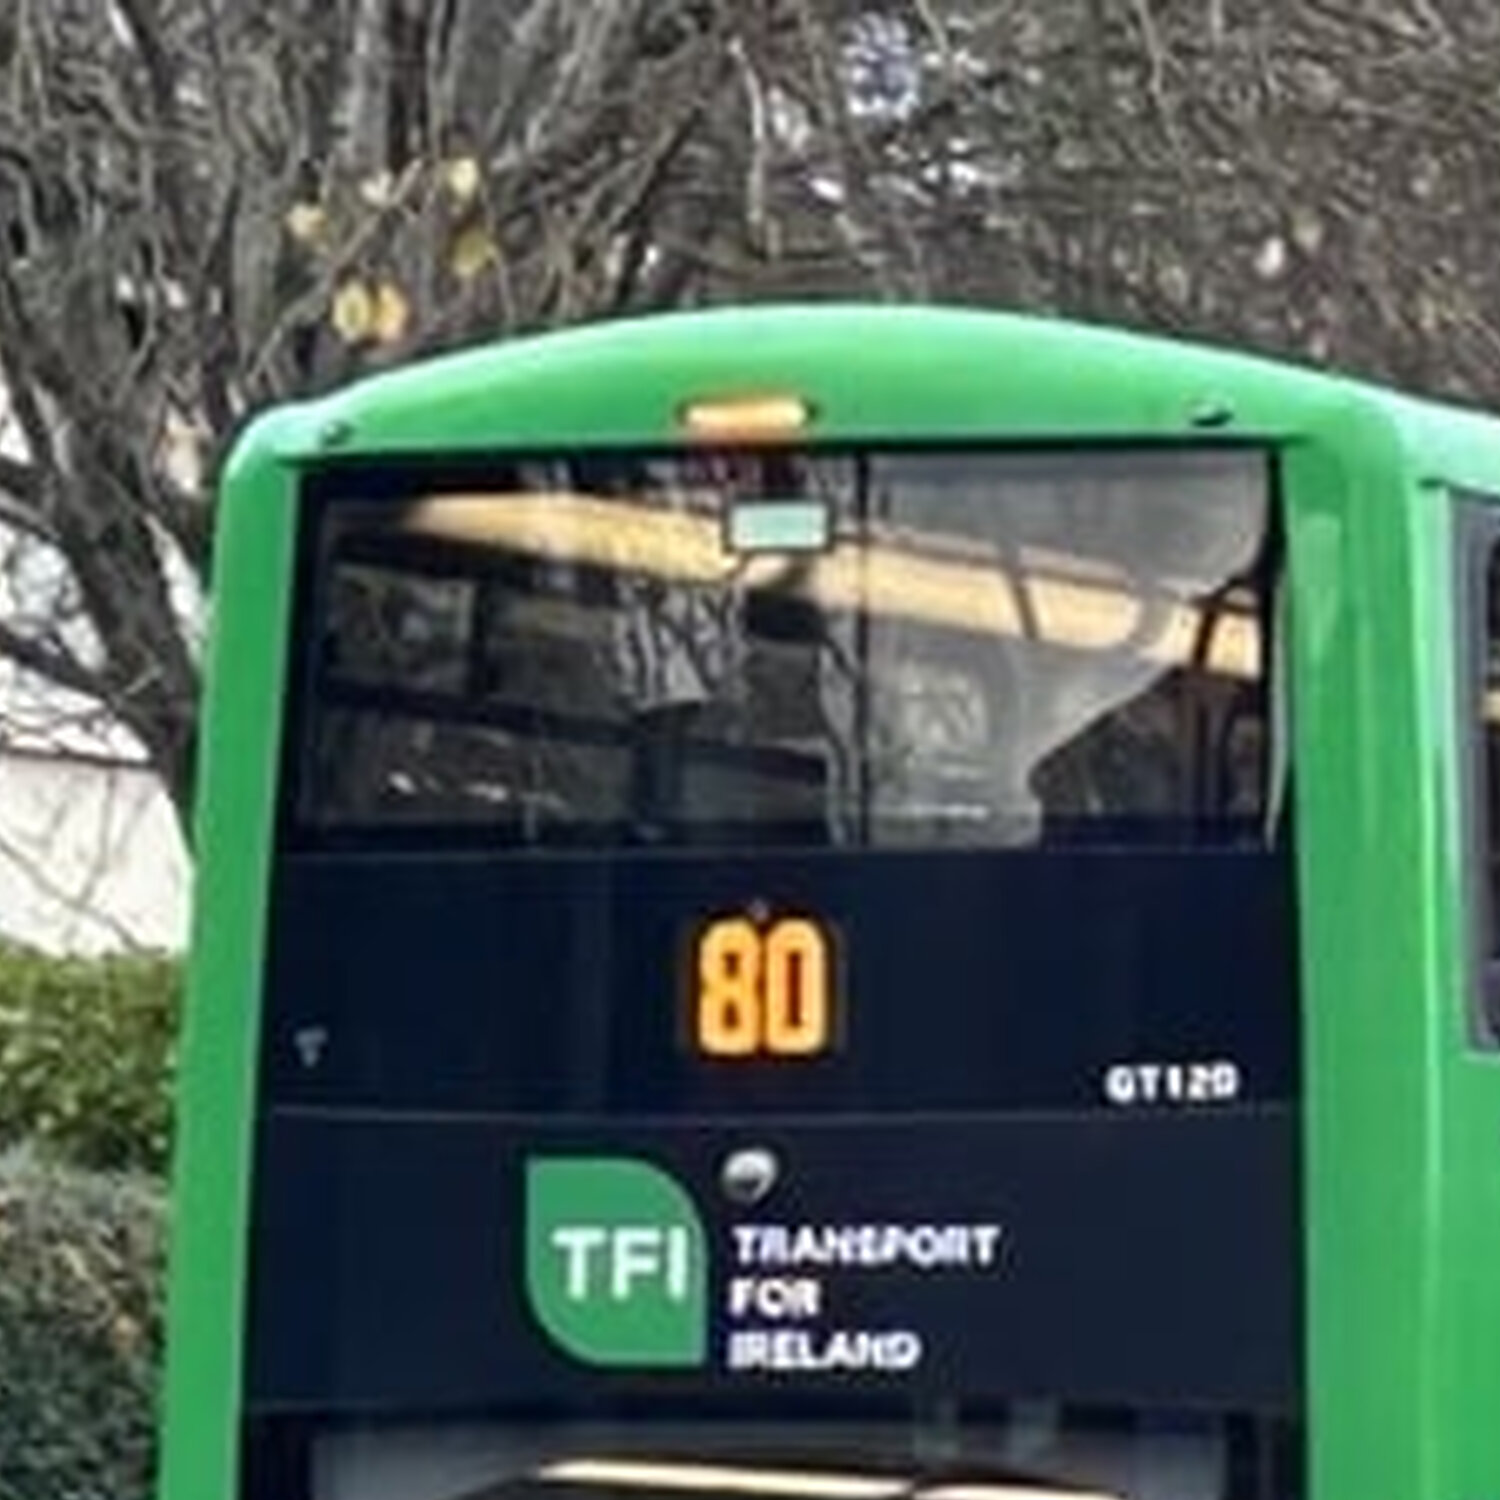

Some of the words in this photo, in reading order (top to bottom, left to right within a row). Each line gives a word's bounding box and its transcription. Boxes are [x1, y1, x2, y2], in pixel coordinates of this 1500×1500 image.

[698, 918, 826, 1054] 80
[552, 1224, 688, 1301] TFI
[732, 1225, 1000, 1266] TRANSPORT
[729, 1277, 820, 1318] FOR
[727, 1330, 922, 1370] IRELAND
